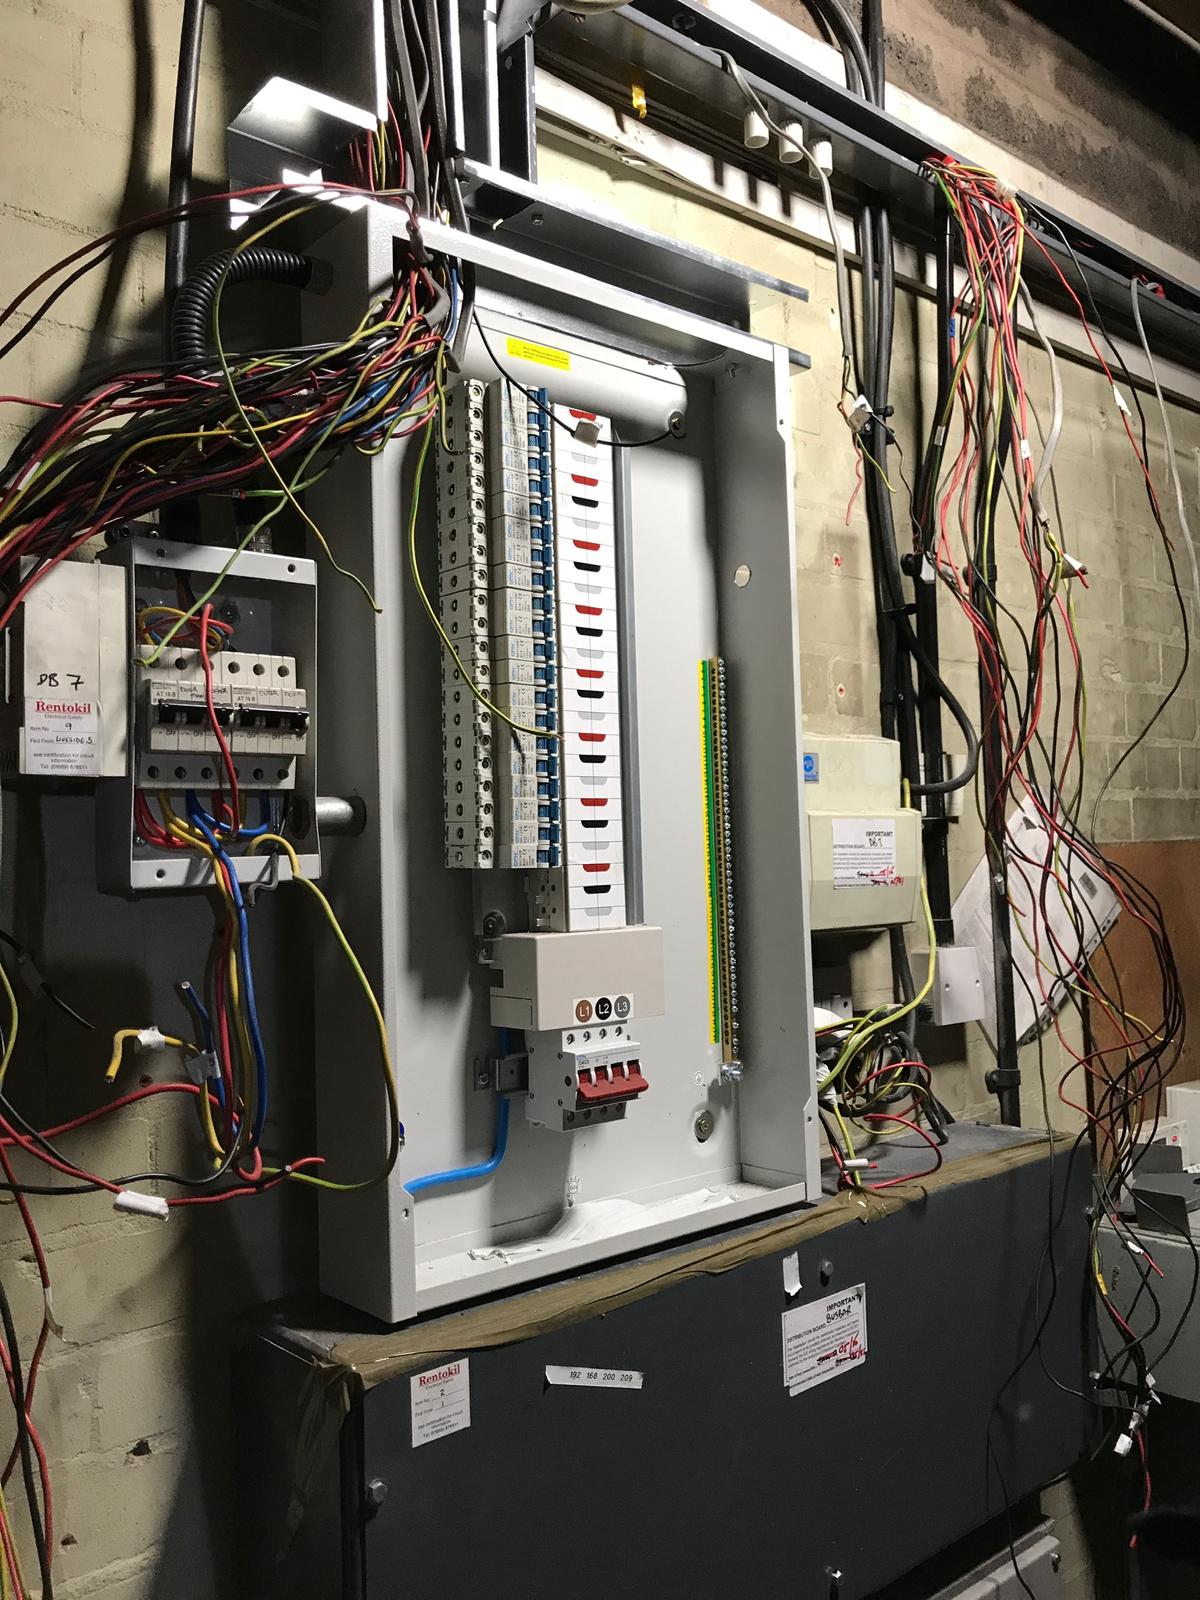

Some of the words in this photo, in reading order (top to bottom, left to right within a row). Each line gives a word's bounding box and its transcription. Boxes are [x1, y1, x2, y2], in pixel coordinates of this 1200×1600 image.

[35, 700, 91, 713] Rentokil
[579, 1006, 591, 1018] L1
[598, 1003, 610, 1014] L2
[617, 1001, 628, 1012] L3
[826, 1293, 862, 1312] IMPORTANT
[418, 1363, 461, 1387] Rentokil
[570, 1371, 581, 1379] 192
[586, 1372, 598, 1380] 168
[602, 1373, 616, 1381] 200
[620, 1374, 633, 1382] 209
